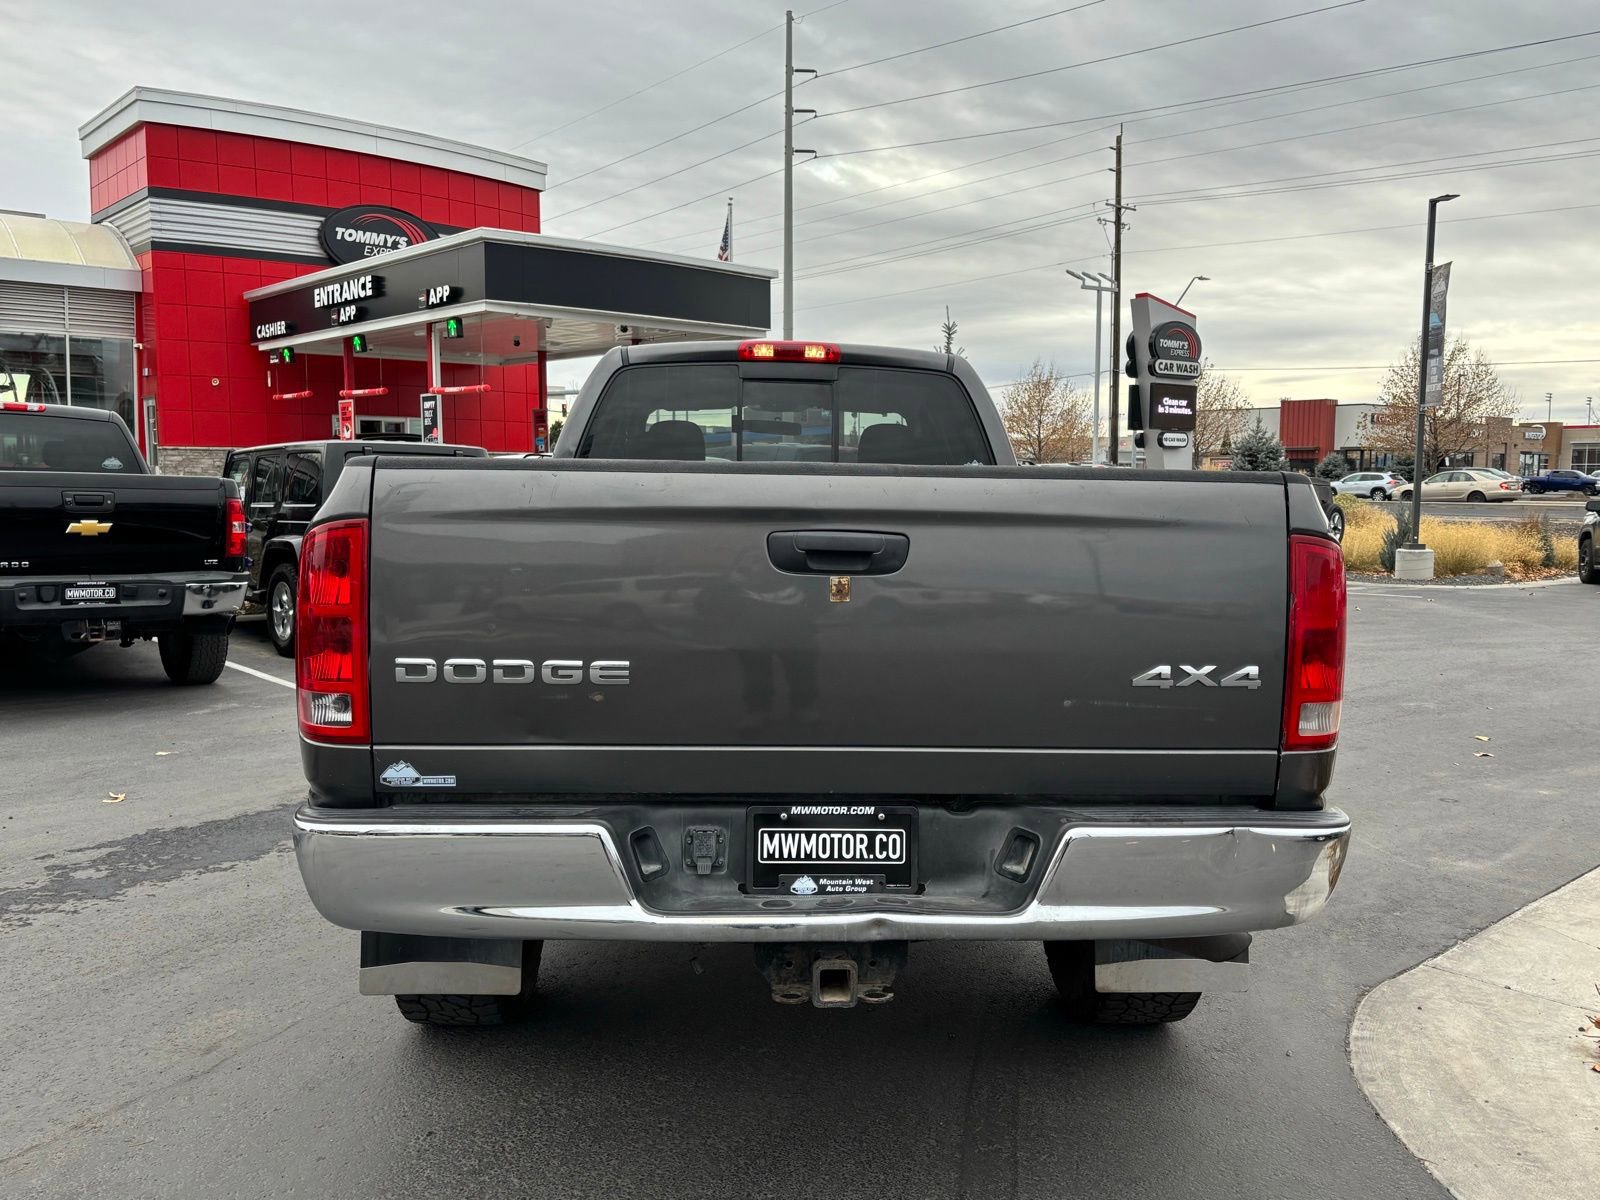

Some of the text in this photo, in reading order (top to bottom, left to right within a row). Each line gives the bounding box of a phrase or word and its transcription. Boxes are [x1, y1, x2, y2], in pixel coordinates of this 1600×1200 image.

[335, 226, 408, 249] TOMMY'S
[314, 275, 373, 308] ENTRANCE
[428, 285, 450, 305] APP
[339, 305, 356, 322] APP
[256, 320, 286, 339] CASHIER
[1159, 338, 1189, 349] TOMMY'S
[1170, 348, 1190, 357] EXPRESS
[1158, 361, 1199, 374] CAR WASH
[1162, 397, 1178, 406] Clean
[67, 589, 114, 598] MWMOTOR.CO
[394, 657, 630, 685] DODGE
[1131, 665, 1262, 690] 4X4
[790, 806, 875, 815] MWMOTOR.COM
[763, 833, 901, 859] MWMOTOR.CO
[845, 885, 867, 893] Group
